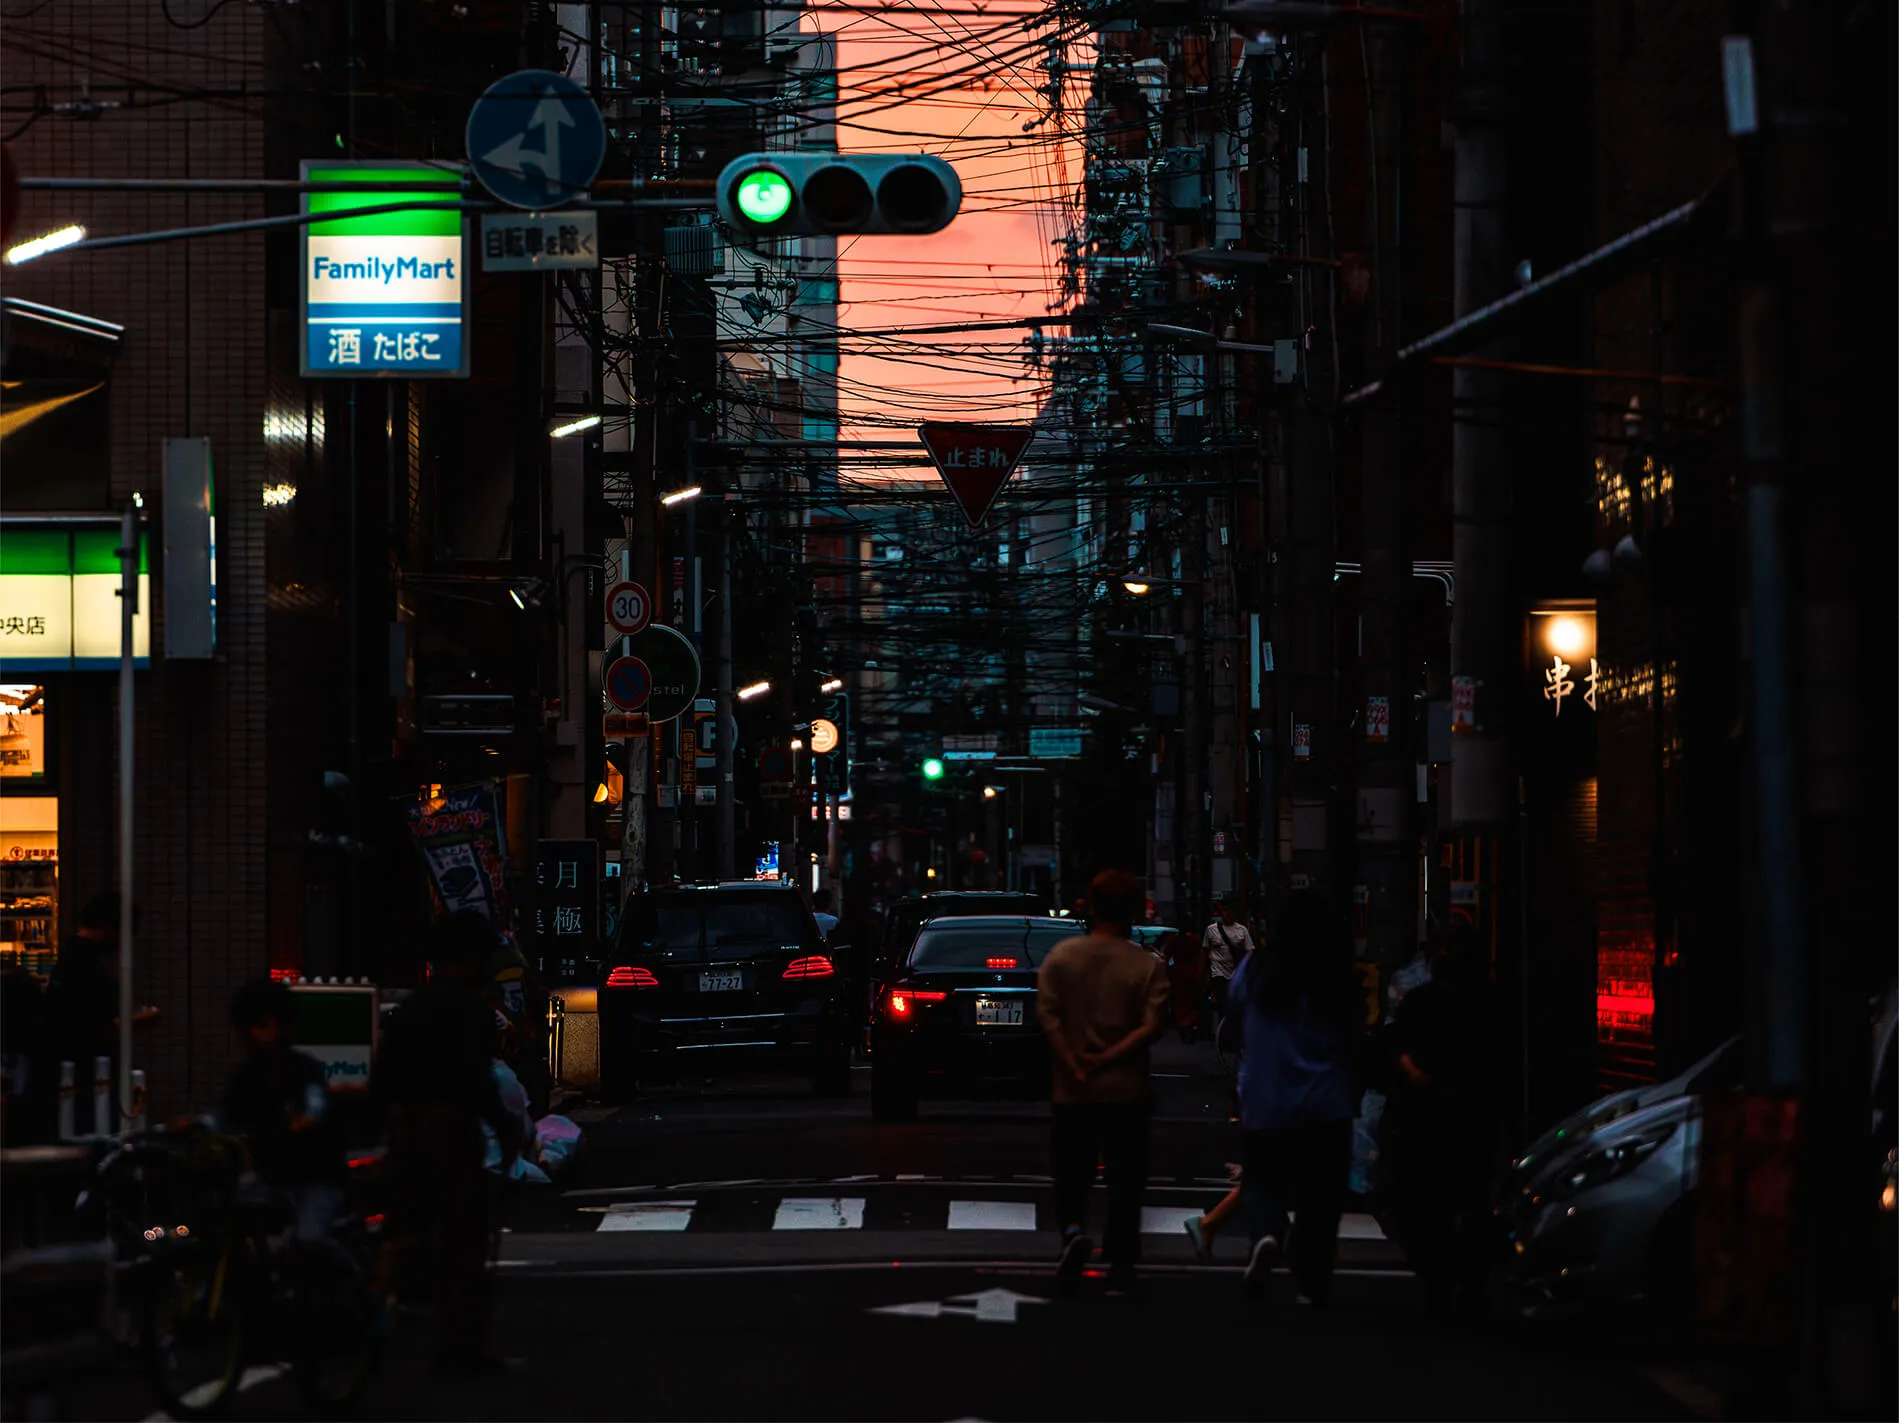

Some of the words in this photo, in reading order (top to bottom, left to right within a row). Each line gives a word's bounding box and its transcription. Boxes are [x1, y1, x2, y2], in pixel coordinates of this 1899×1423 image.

[486, 224, 593, 258] 自転車を除く
[313, 256, 456, 285] FamilyMart
[328, 328, 362, 365] 酒
[373, 331, 442, 361] たばこ
[943, 445, 1010, 468] 止まれ
[616, 597, 641, 619] 30
[0, 616, 46, 635] 央店
[553, 860, 584, 937] 月極
